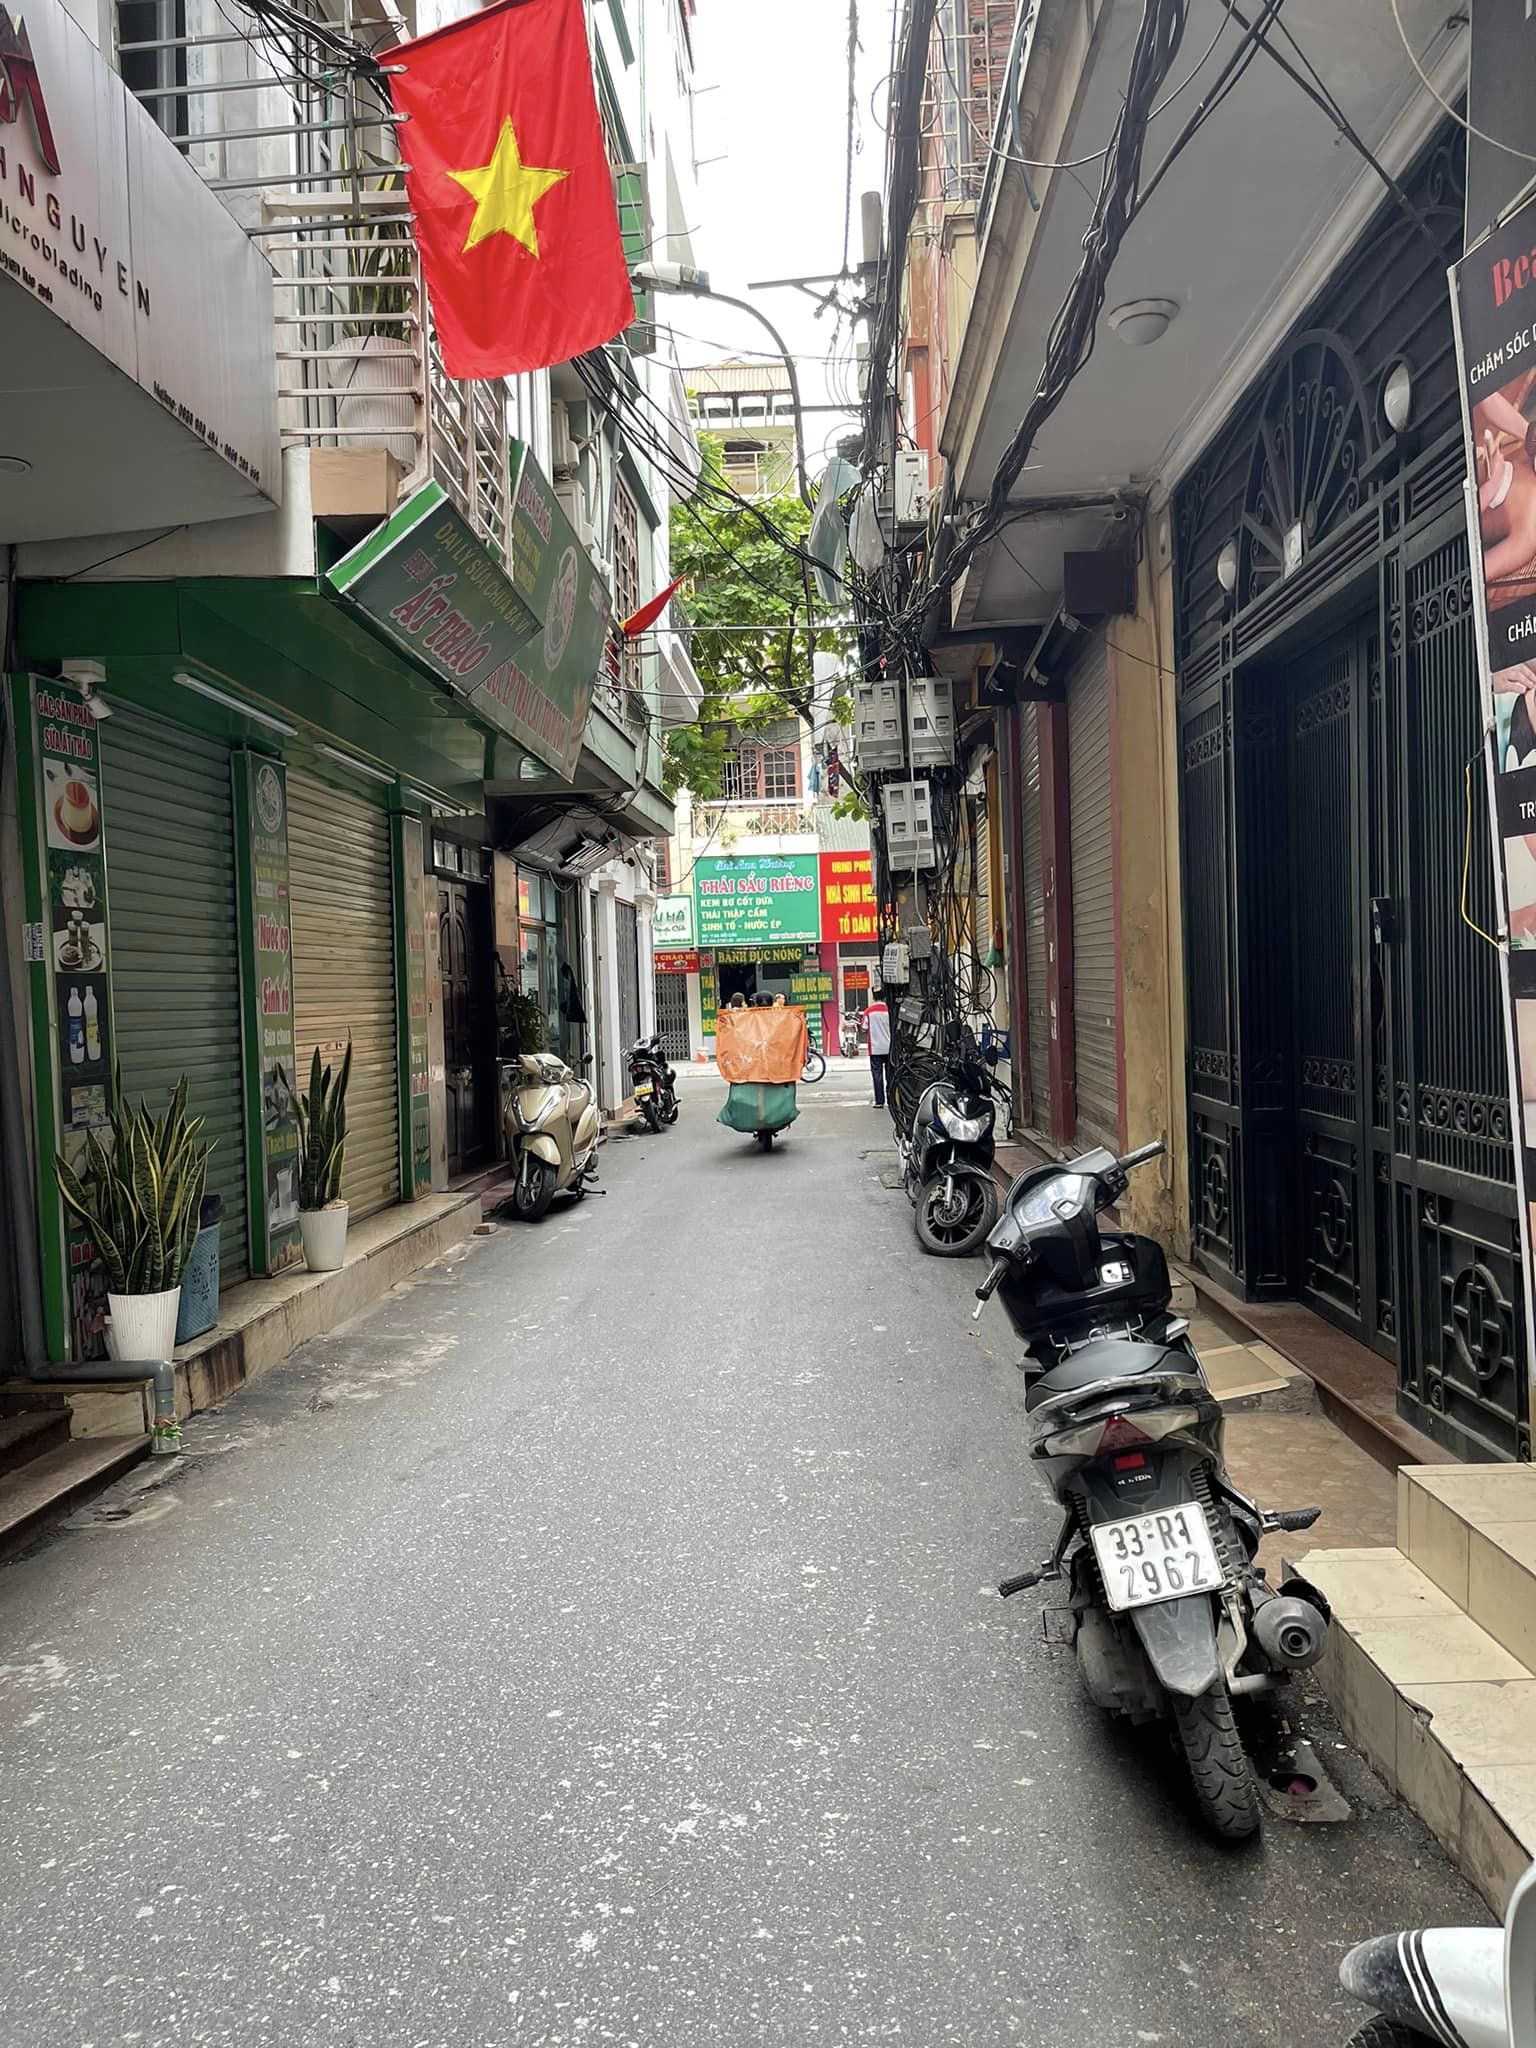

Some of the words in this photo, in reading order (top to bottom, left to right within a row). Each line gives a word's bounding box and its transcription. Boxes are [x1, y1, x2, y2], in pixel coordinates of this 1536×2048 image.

[1470, 348, 1504, 385] CHĂM
[1505, 330, 1530, 360] SÓC
[422, 609, 494, 676] THẢO
[769, 873, 815, 892] RIÊNG
[700, 898, 720, 907] KEM
[842, 884, 861, 904] SINH
[701, 921, 722, 932] SINH
[851, 913, 871, 934] DÂN
[718, 948, 747, 963] BÁNH
[772, 945, 802, 961] NÓNG
[1119, 1551, 1209, 1601] 2962
